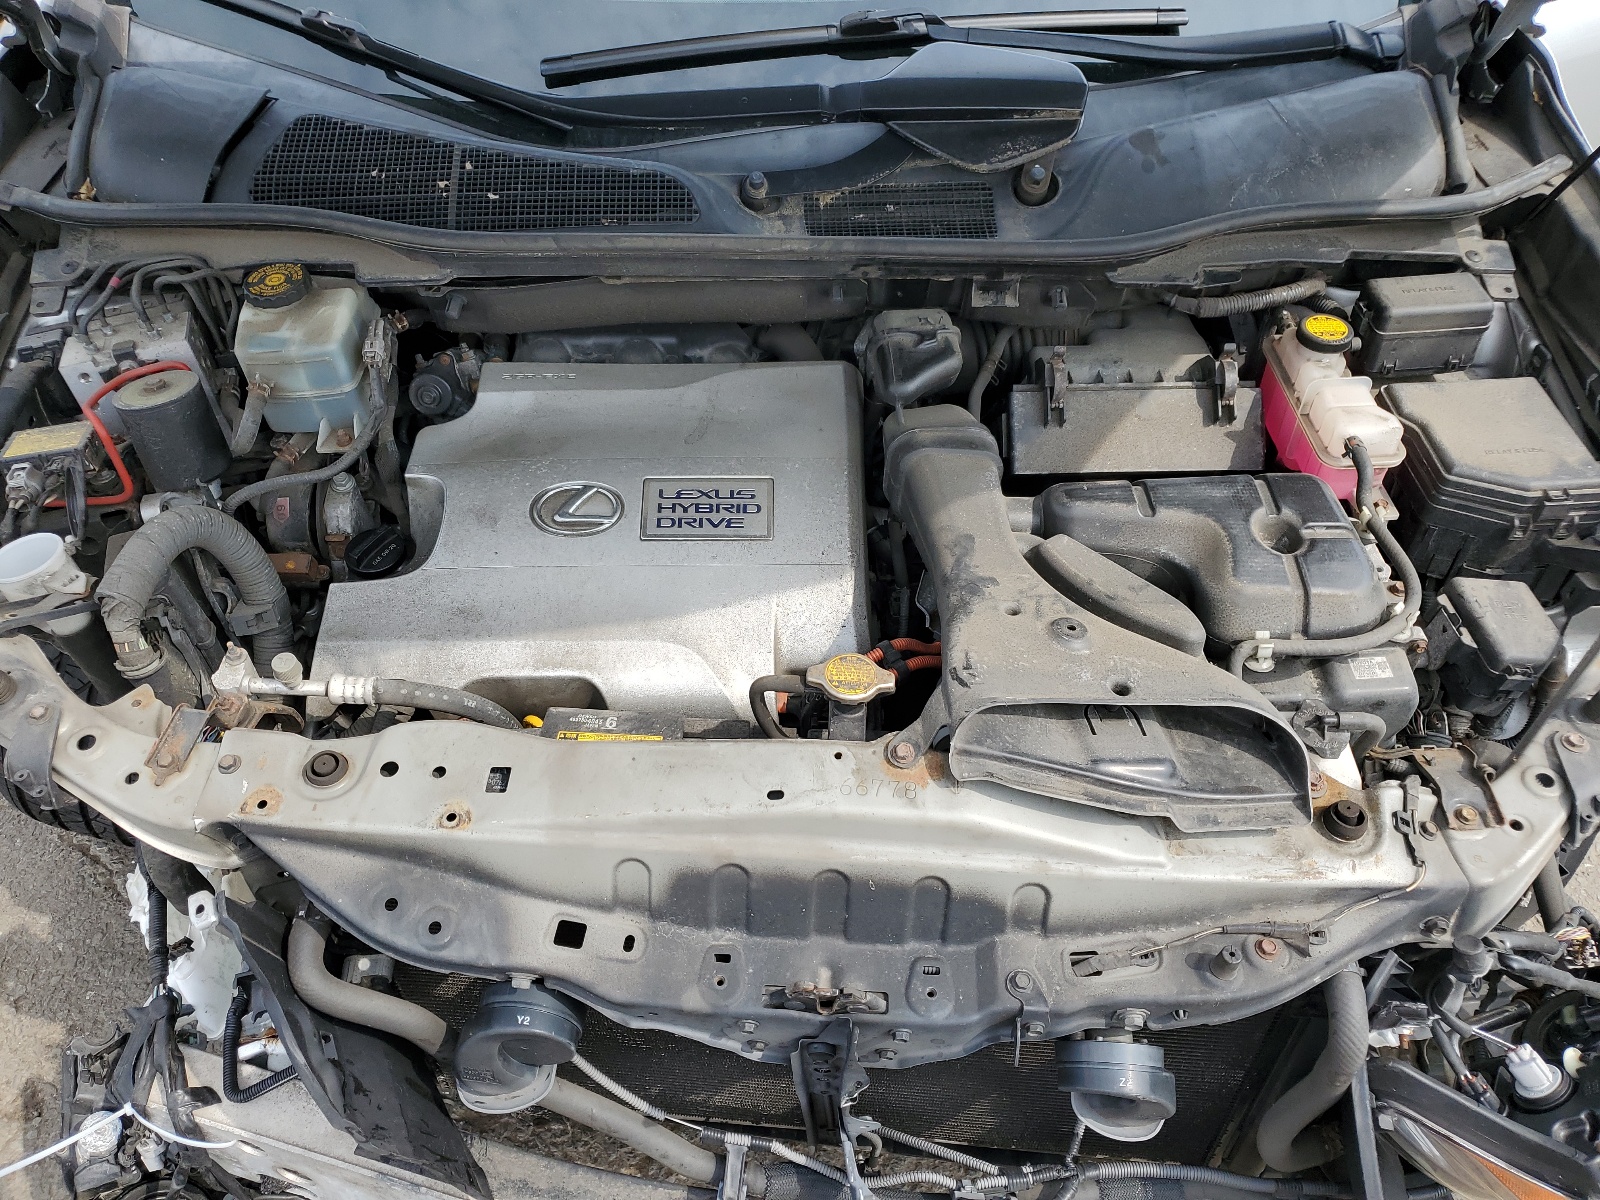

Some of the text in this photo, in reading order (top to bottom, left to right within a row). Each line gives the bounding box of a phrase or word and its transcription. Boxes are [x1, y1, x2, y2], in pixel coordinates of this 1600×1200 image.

[658, 488, 757, 500] LEXUS
[657, 502, 762, 514] HYBRID
[656, 517, 745, 529] DRIVE
[604, 716, 618, 729] 6
[839, 777, 917, 800] 66778
[516, 1015, 531, 1026] Y2
